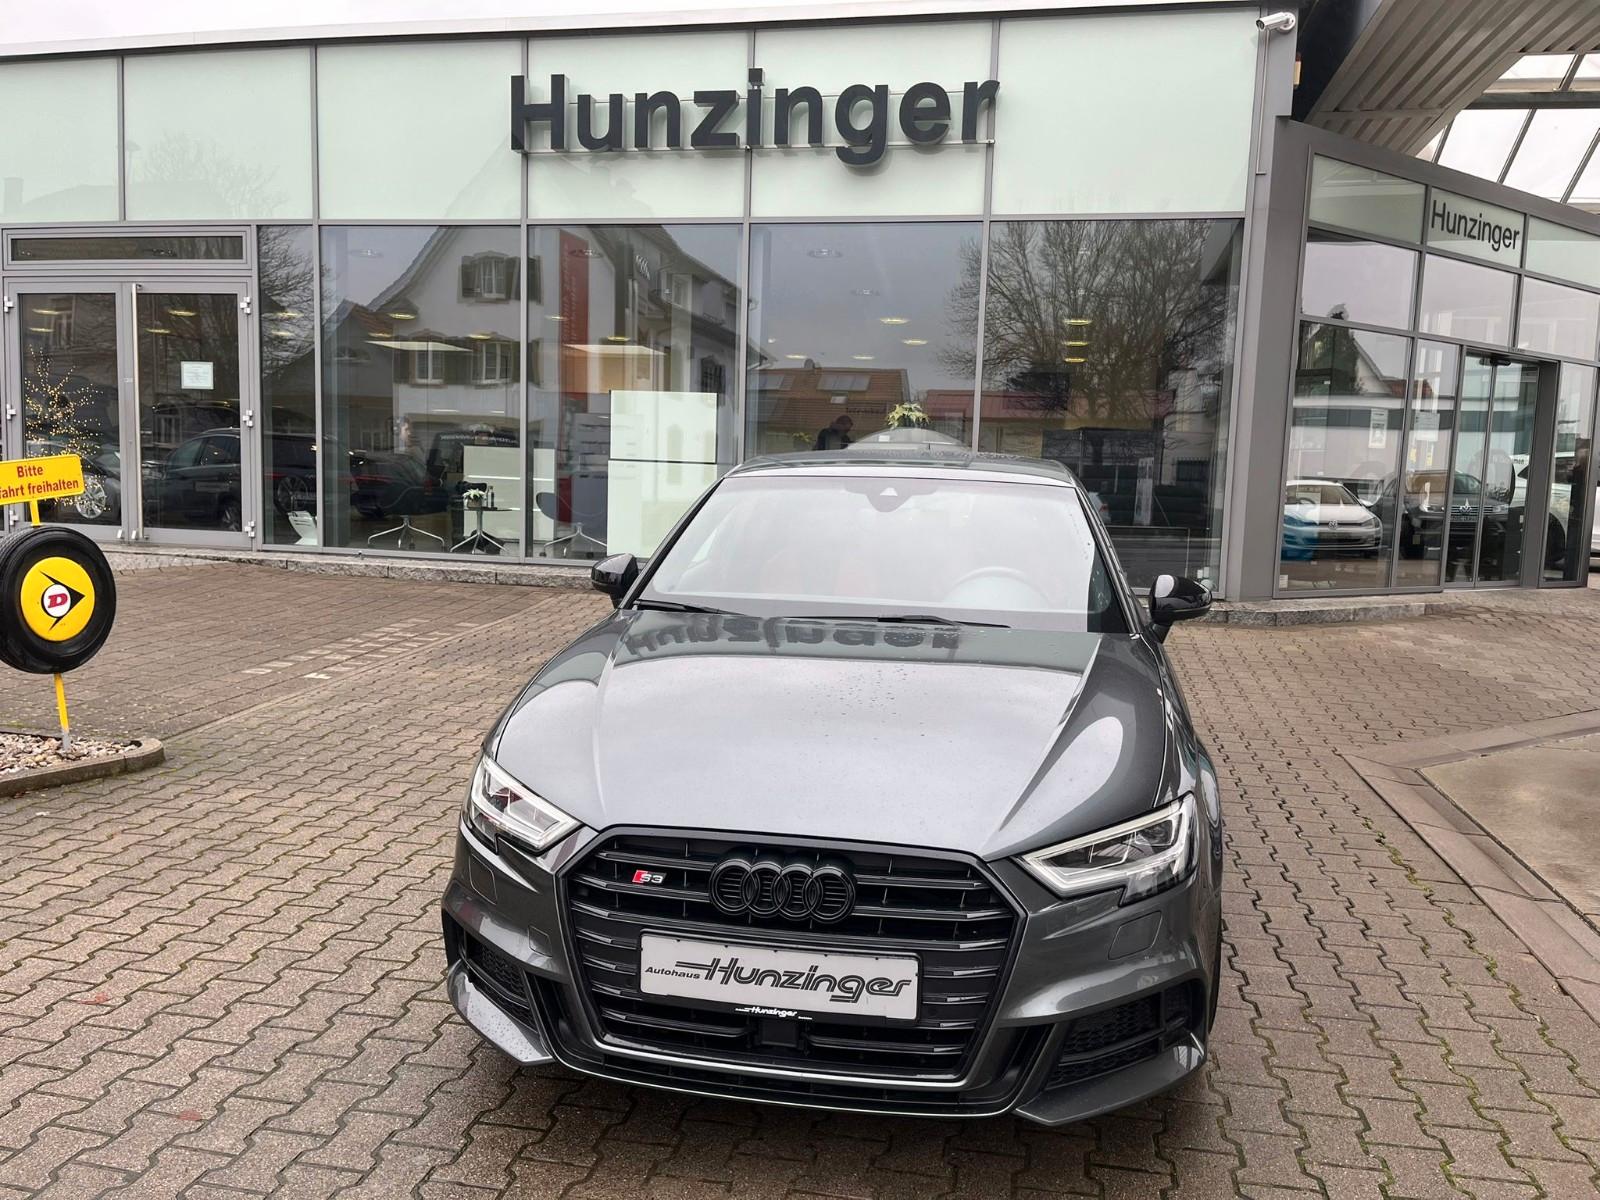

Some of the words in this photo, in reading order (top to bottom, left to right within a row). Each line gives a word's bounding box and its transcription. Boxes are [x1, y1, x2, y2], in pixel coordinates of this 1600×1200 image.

[510, 68, 999, 170] Hunzinger
[1431, 199, 1520, 252] Hunzinger
[16, 465, 43, 478] Bitte
[28, 480, 79, 494] freihalten
[47, 592, 69, 609] D
[640, 873, 664, 884] S3
[645, 966, 700, 979] Autohaus
[675, 957, 912, 1003] Hunzinger
[744, 1006, 798, 1017] Hunzinger
